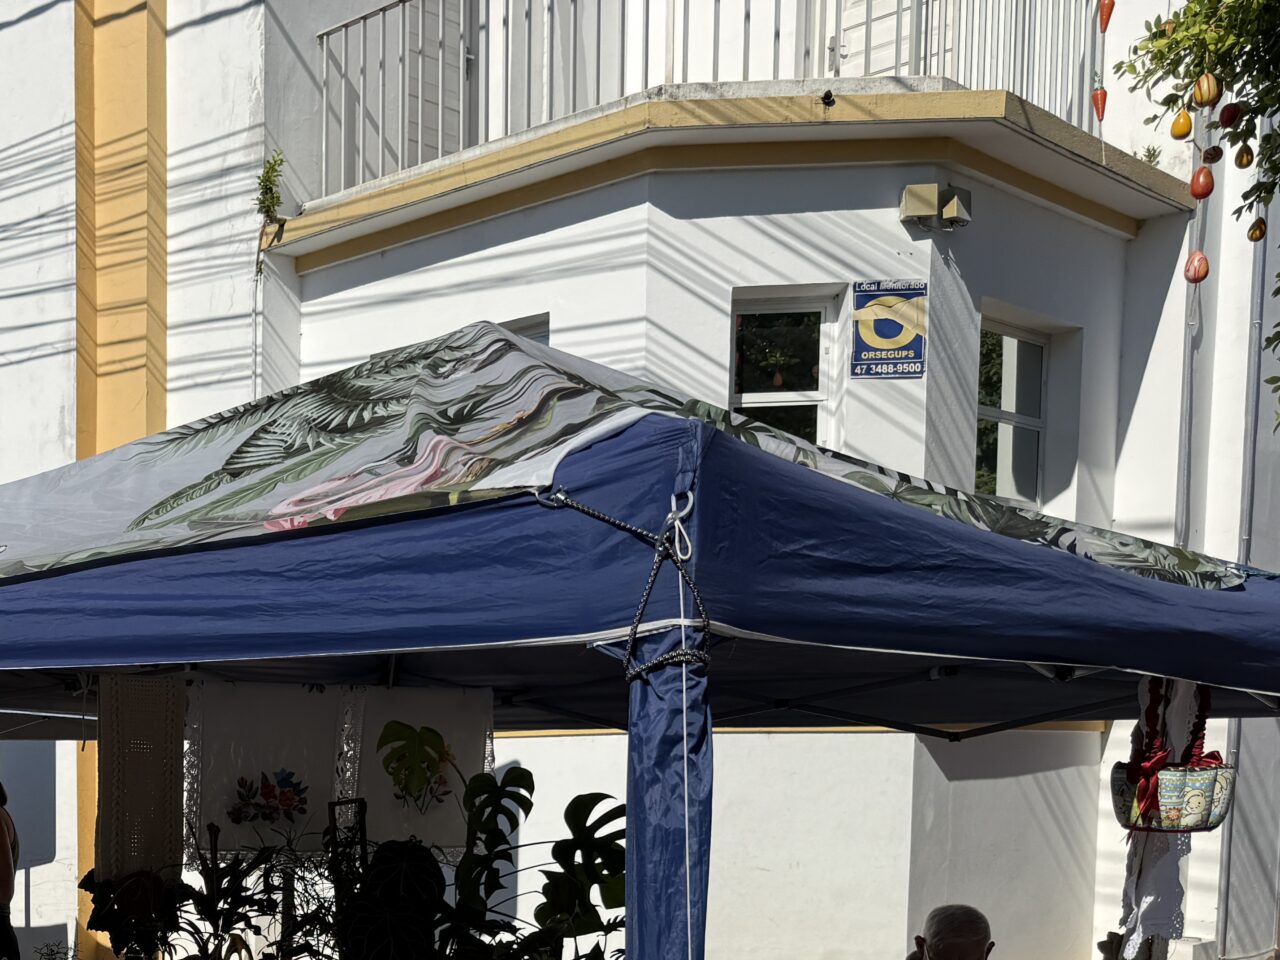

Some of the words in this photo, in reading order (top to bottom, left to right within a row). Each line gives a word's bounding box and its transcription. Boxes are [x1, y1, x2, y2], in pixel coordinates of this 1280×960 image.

[855, 282, 878, 291] Local
[861, 350, 915, 359] ORSEGUPS
[854, 365, 867, 374] 47
[870, 363, 921, 374] 3488-9500
